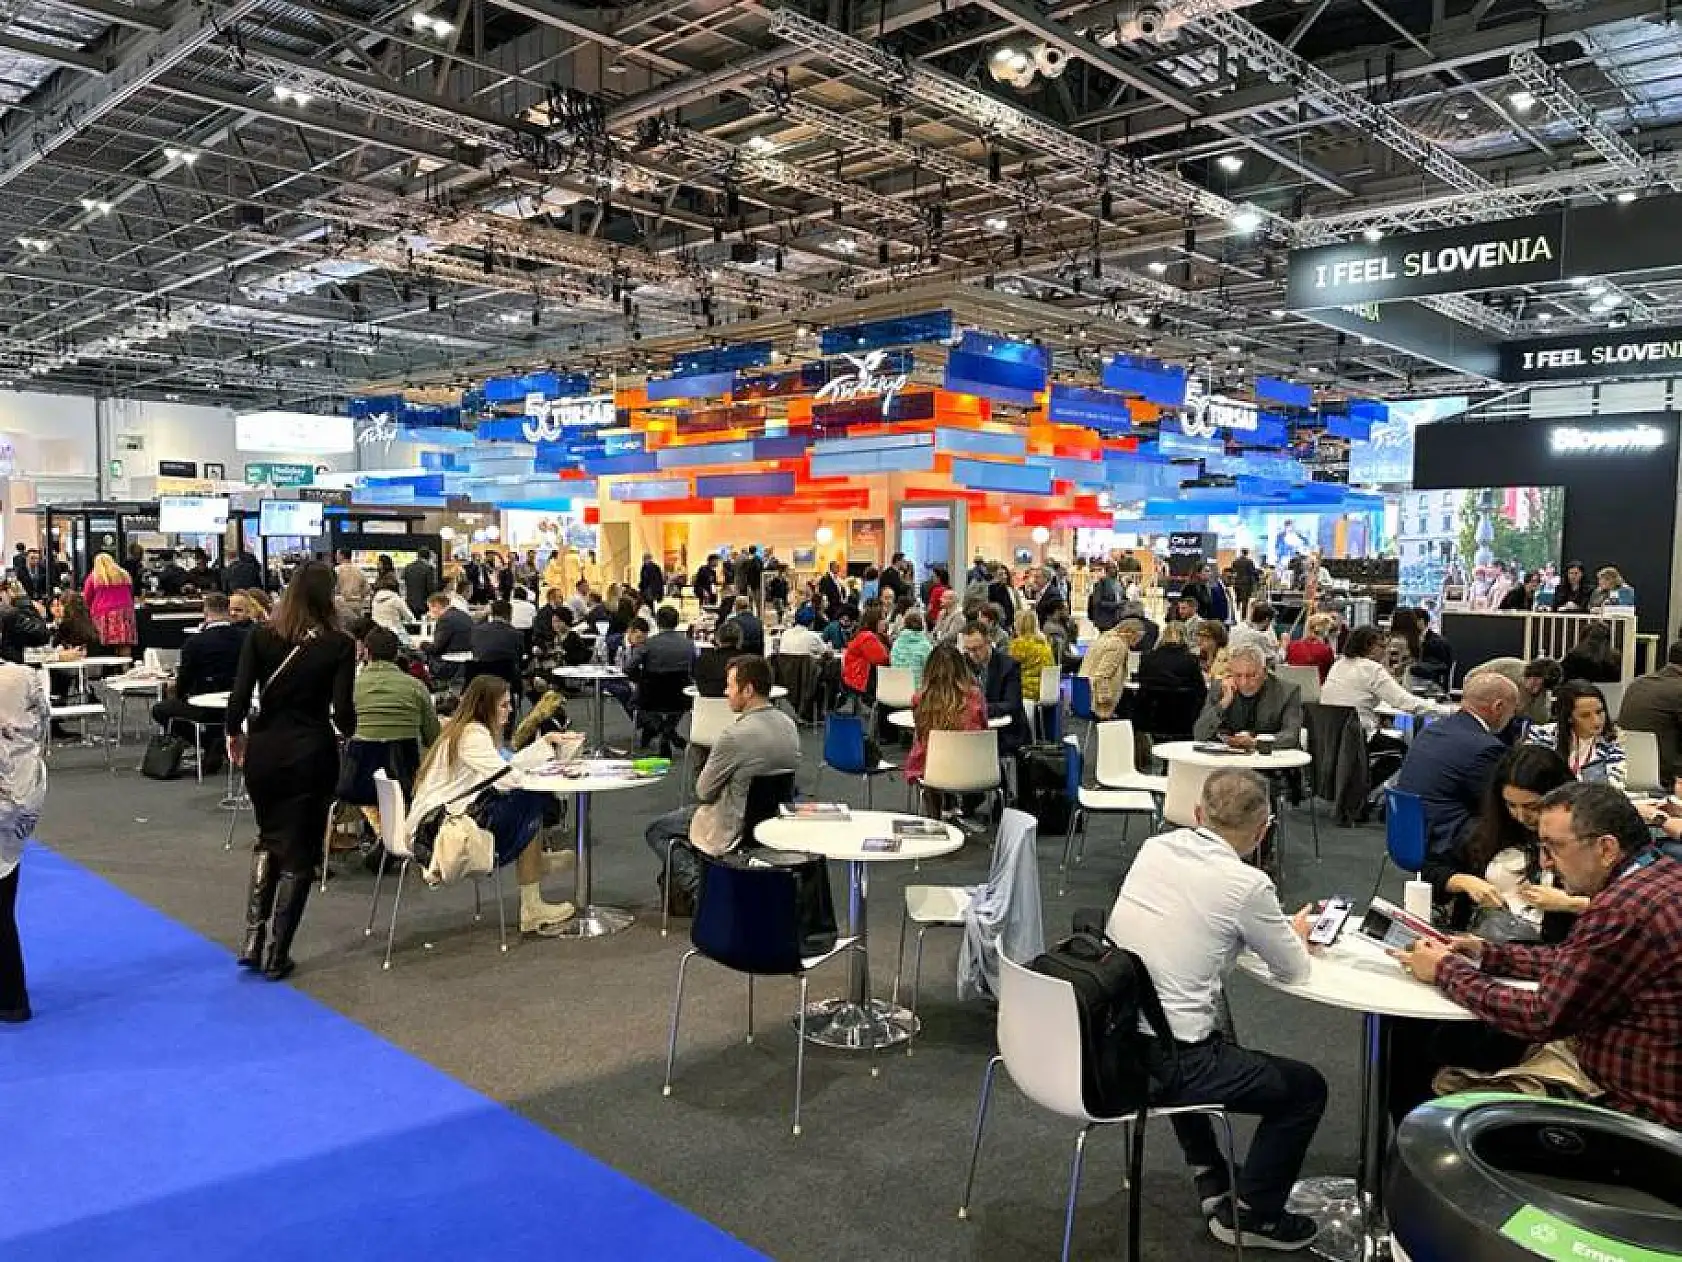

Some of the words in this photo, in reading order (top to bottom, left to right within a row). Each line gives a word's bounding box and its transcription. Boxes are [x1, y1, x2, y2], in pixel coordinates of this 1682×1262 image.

[1315, 264, 1327, 289] I
[1333, 256, 1397, 287] FEEL
[1403, 234, 1553, 278] SLOVENIA
[1522, 351, 1534, 370] I
[1536, 347, 1587, 369] FEEL
